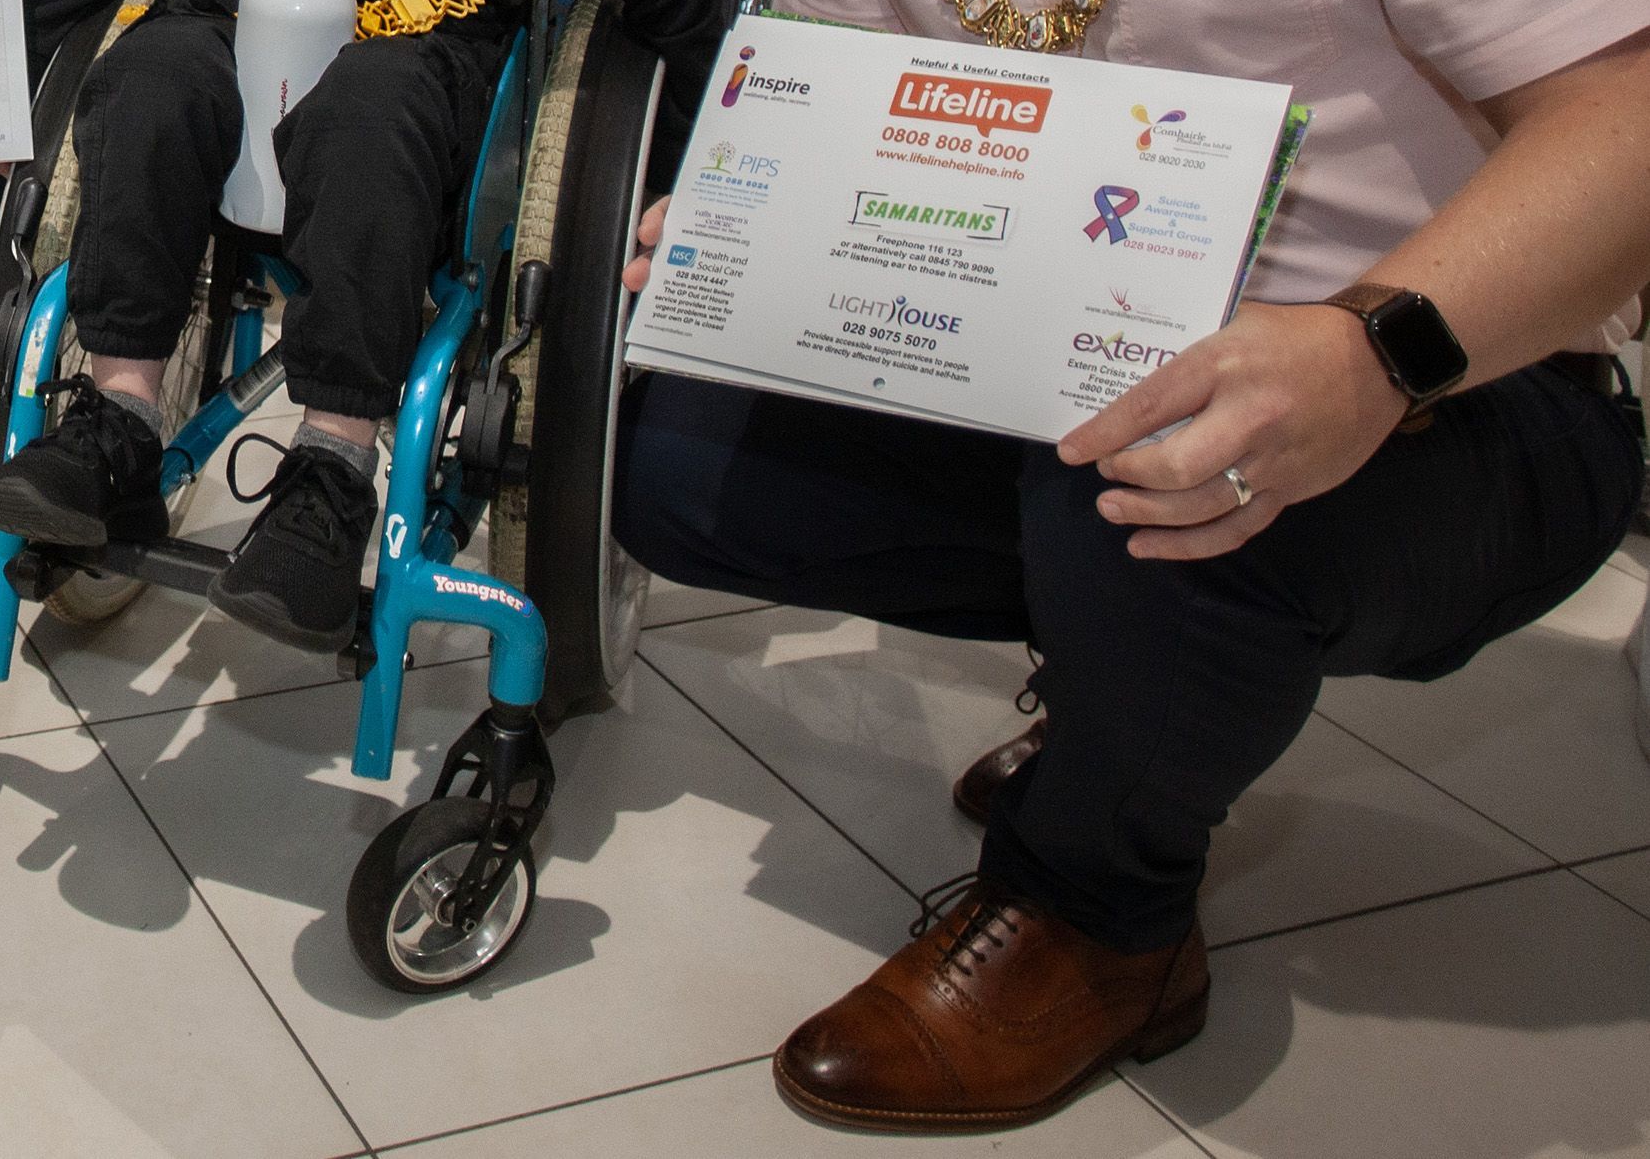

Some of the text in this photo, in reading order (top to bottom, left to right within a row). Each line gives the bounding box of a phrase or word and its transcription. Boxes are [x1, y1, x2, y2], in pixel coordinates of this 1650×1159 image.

[911, 57, 1050, 83] Helpful & Useful Contacts
[748, 72, 811, 95] inspire
[900, 81, 1038, 124] Lifeline
[1153, 125, 1206, 141] Comhairle
[882, 126, 1029, 163] 0808 808 8000
[738, 154, 781, 177] PIPS
[876, 148, 1025, 181] www.lifelinehelpline.info
[1139, 152, 1206, 169] 028 9020 2030
[700, 173, 722, 182] 0800
[726, 177, 743, 186] 088
[1145, 204, 1207, 221] Awareness
[1158, 196, 1200, 210] Suicide
[863, 200, 996, 232] SAMARITANS
[1168, 219, 1177, 227] &
[1128, 222, 1212, 245] Support Group
[672, 251, 691, 261] HSC
[876, 235, 962, 257] Freephone 116 123
[1123, 239, 1207, 261] 028 9023 9967
[701, 250, 748, 266] Health and
[830, 249, 998, 287] 24/7 listening ear to those in distress
[852, 243, 906, 259] alternatively
[909, 252, 925, 262] call
[928, 256, 950, 267] 0845
[952, 260, 969, 270] 790
[971, 263, 994, 275] 9090
[676, 270, 728, 286] 028 9074 4447
[697, 261, 744, 278] Social Care
[655, 296, 677, 304] service
[678, 299, 706, 309] provides
[724, 307, 733, 315] for
[664, 287, 675, 295] The
[688, 291, 700, 299] Out
[709, 296, 729, 305] Hours
[652, 312, 667, 320] your
[669, 315, 682, 323] own
[702, 322, 724, 331] closed
[655, 304, 727, 322] urgent problems when
[843, 321, 937, 351] 028 9075 5070
[804, 329, 969, 372] Provides accessible support services to people
[1073, 332, 1178, 368] extern
[797, 340, 970, 384] who are directly affected by suicide and self-harm
[1067, 358, 1126, 378] Extern Crisis
[1060, 389, 1097, 403] Accessible
[1079, 382, 1102, 394] 0800
[433, 575, 524, 611] Youngster
